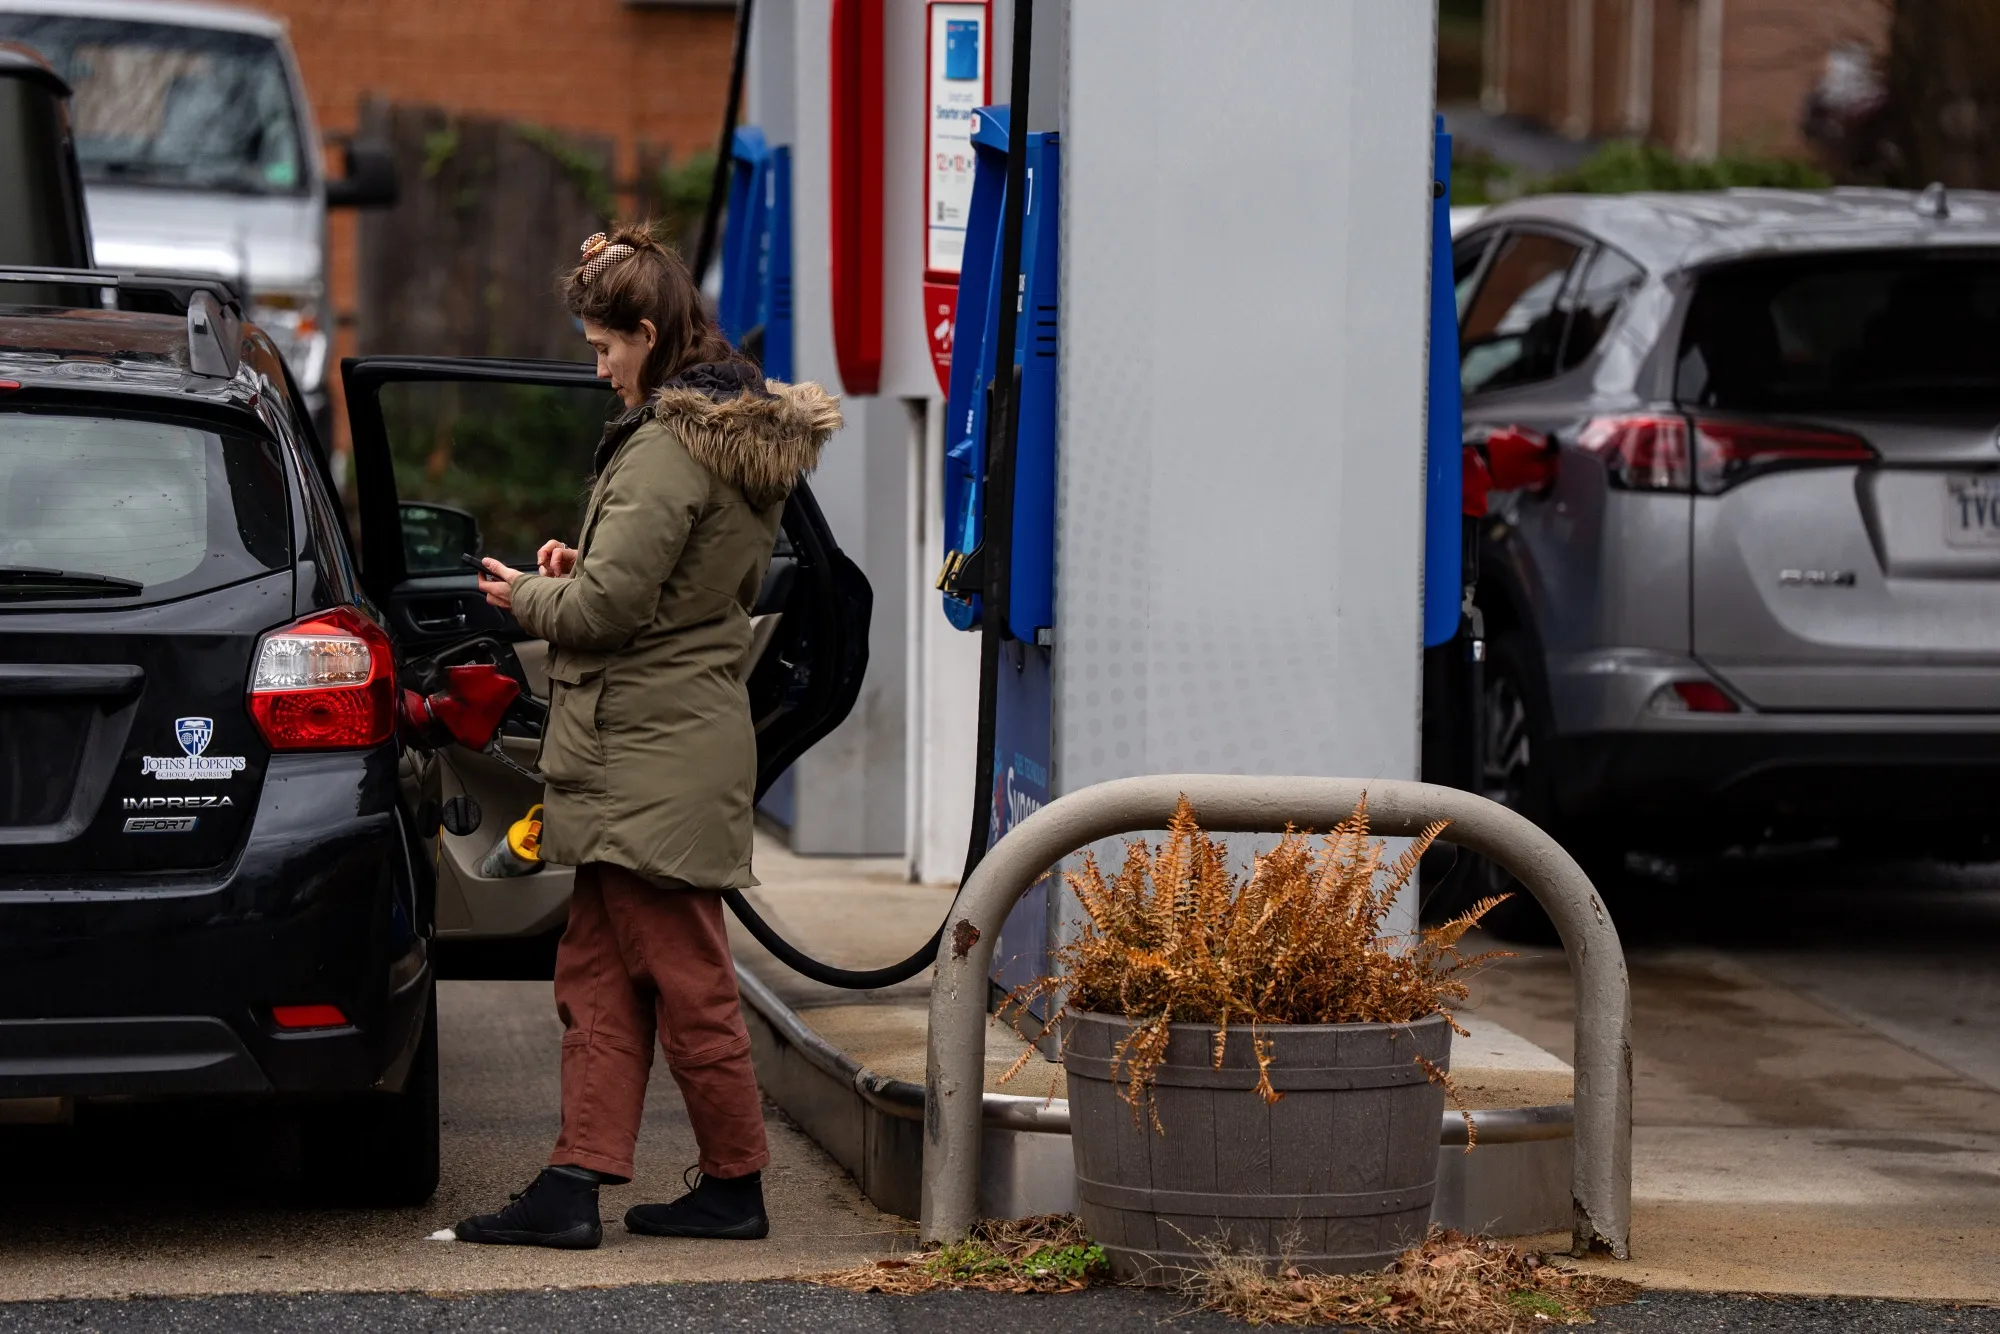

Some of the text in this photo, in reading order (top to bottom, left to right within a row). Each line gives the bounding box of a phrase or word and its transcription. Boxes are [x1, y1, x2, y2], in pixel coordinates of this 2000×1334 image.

[143, 757, 245, 773] JOHNS HOPKINS
[189, 771, 195, 781] of
[123, 796, 234, 810] IMPREZA
[130, 819, 191, 831] SPORT
